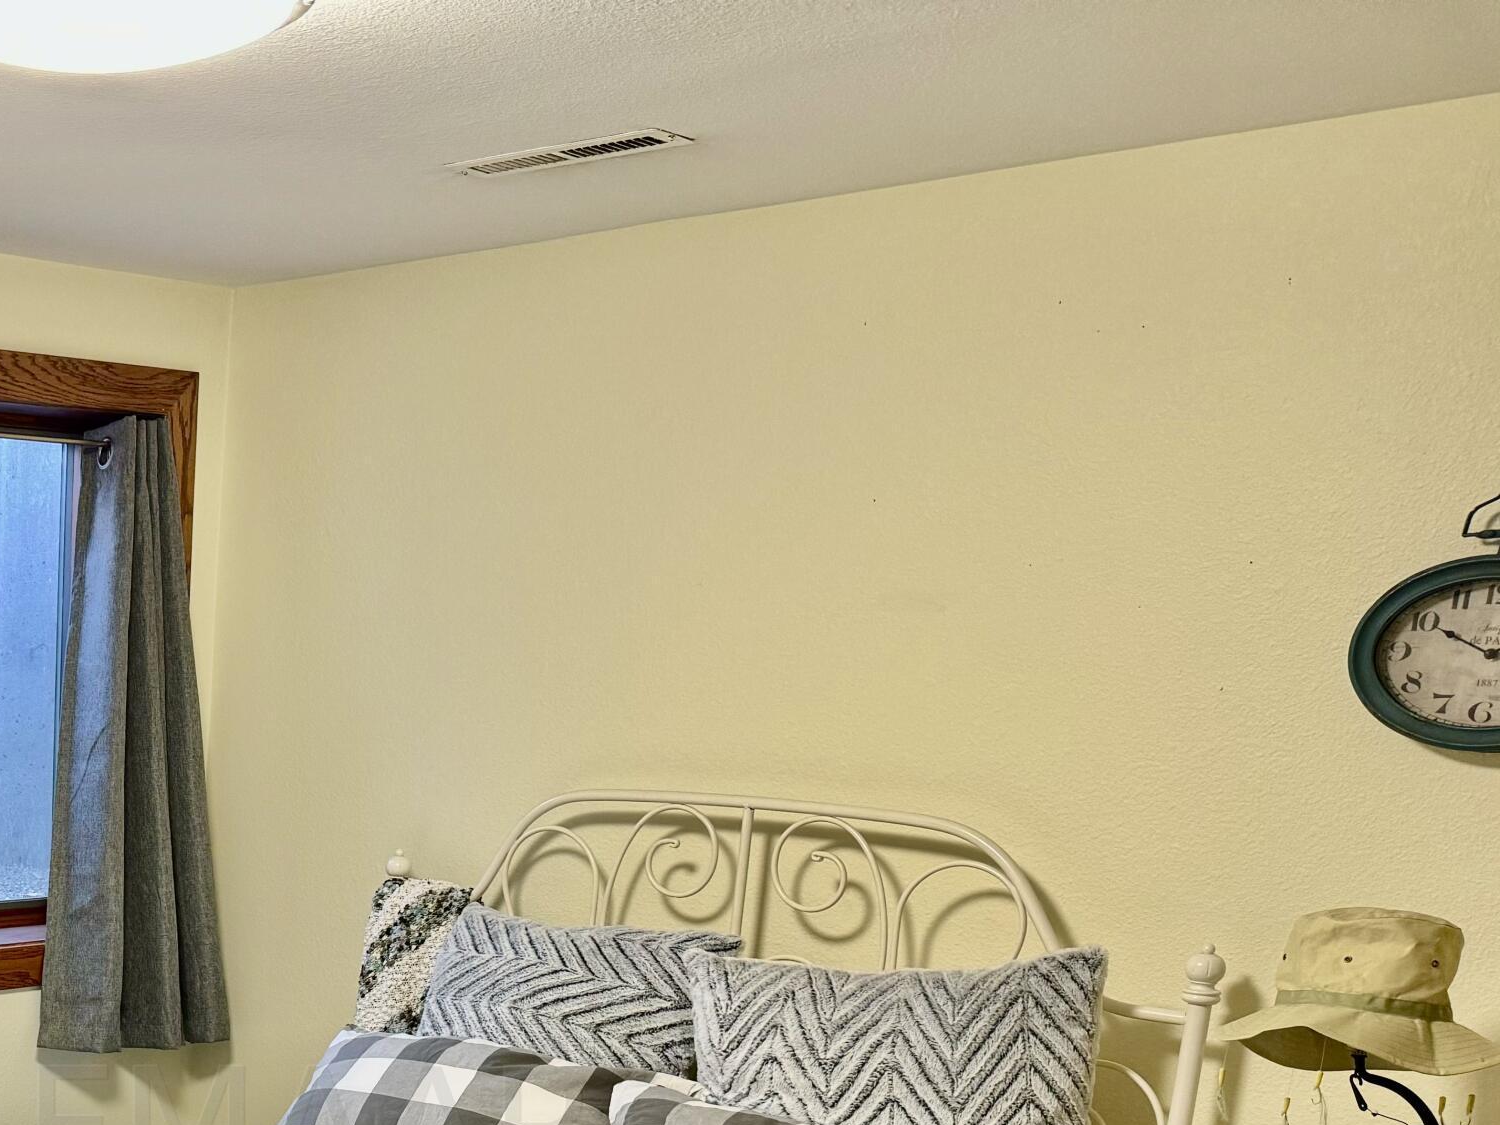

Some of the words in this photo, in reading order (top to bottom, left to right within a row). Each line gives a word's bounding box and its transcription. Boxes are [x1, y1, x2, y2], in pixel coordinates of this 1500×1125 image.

[1451, 590, 1471, 609] 11
[1411, 611, 1440, 632] 10
[1387, 641, 1412, 662] 9
[1401, 670, 1423, 693] 8
[1432, 692, 1455, 714] 7
[1467, 701, 1493, 723] 6
